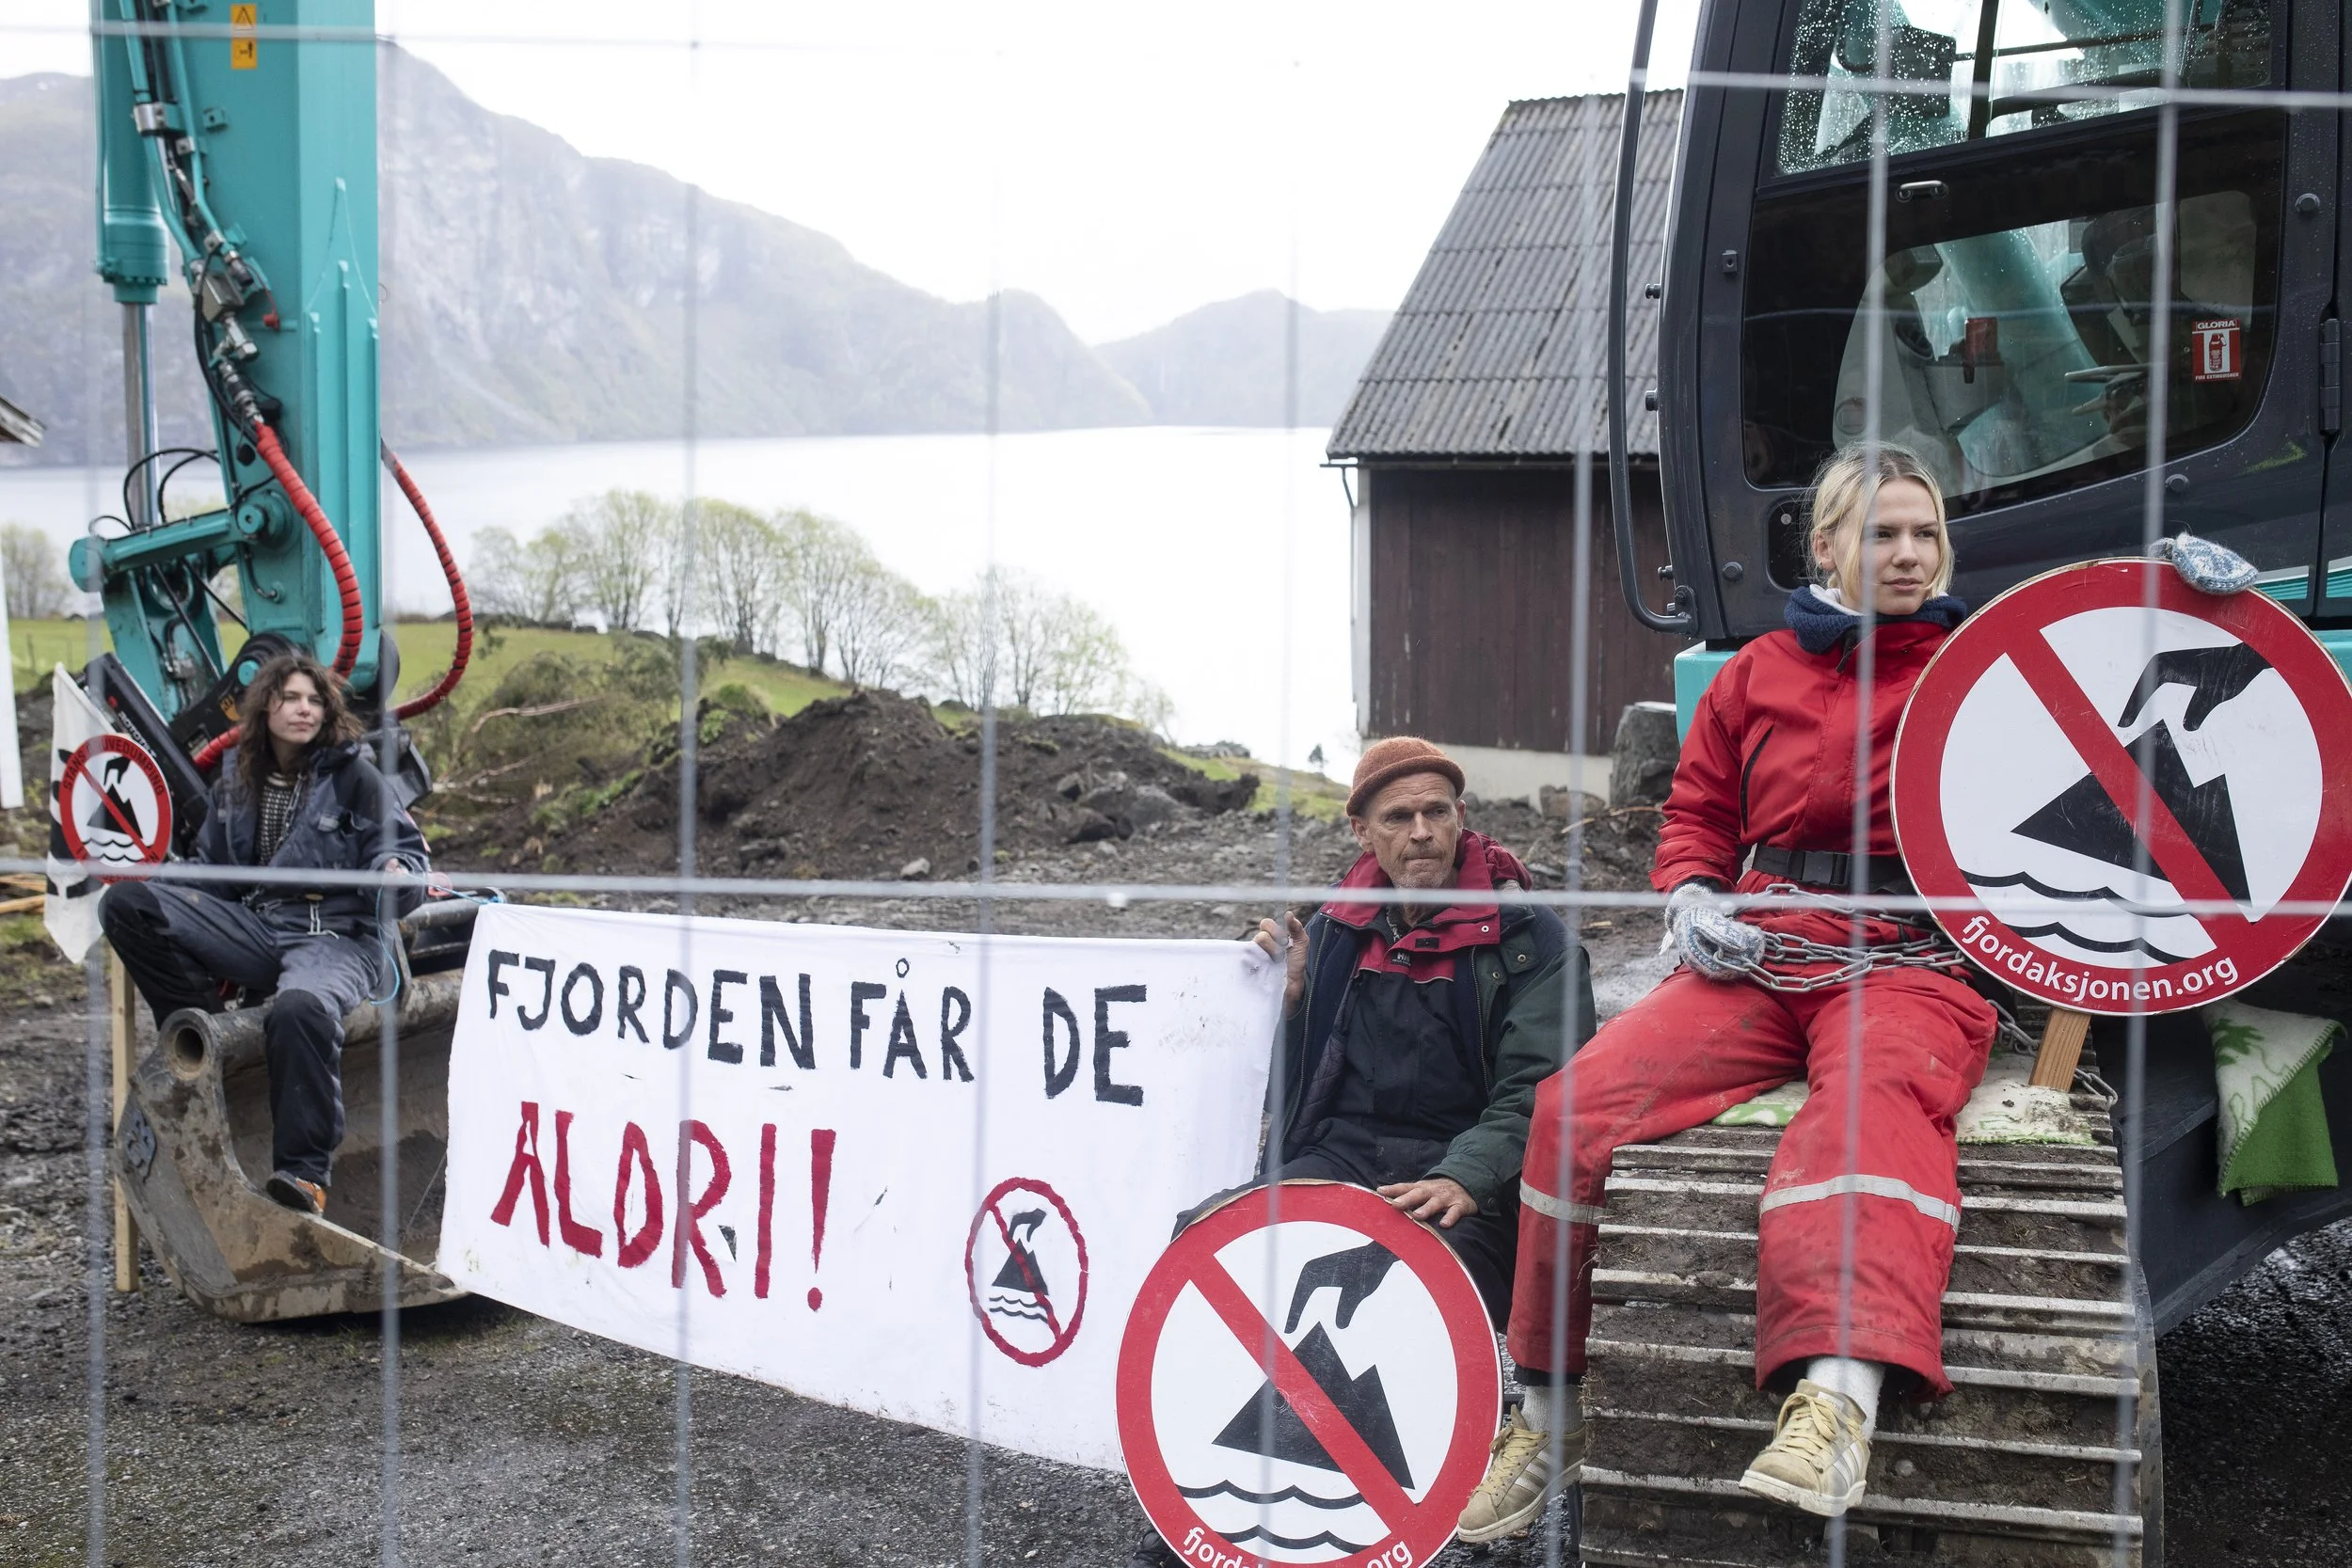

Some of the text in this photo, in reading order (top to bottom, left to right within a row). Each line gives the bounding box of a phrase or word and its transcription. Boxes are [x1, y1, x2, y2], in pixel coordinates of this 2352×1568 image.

[2197, 320, 2235, 329] GLORIA
[62, 750, 87, 790] STANS
[1962, 915, 2238, 1001] fjordaksjonen.org
[487, 949, 1147, 1106] FJORDEN FÅR DE
[490, 1101, 836, 1312] ALDRI!
